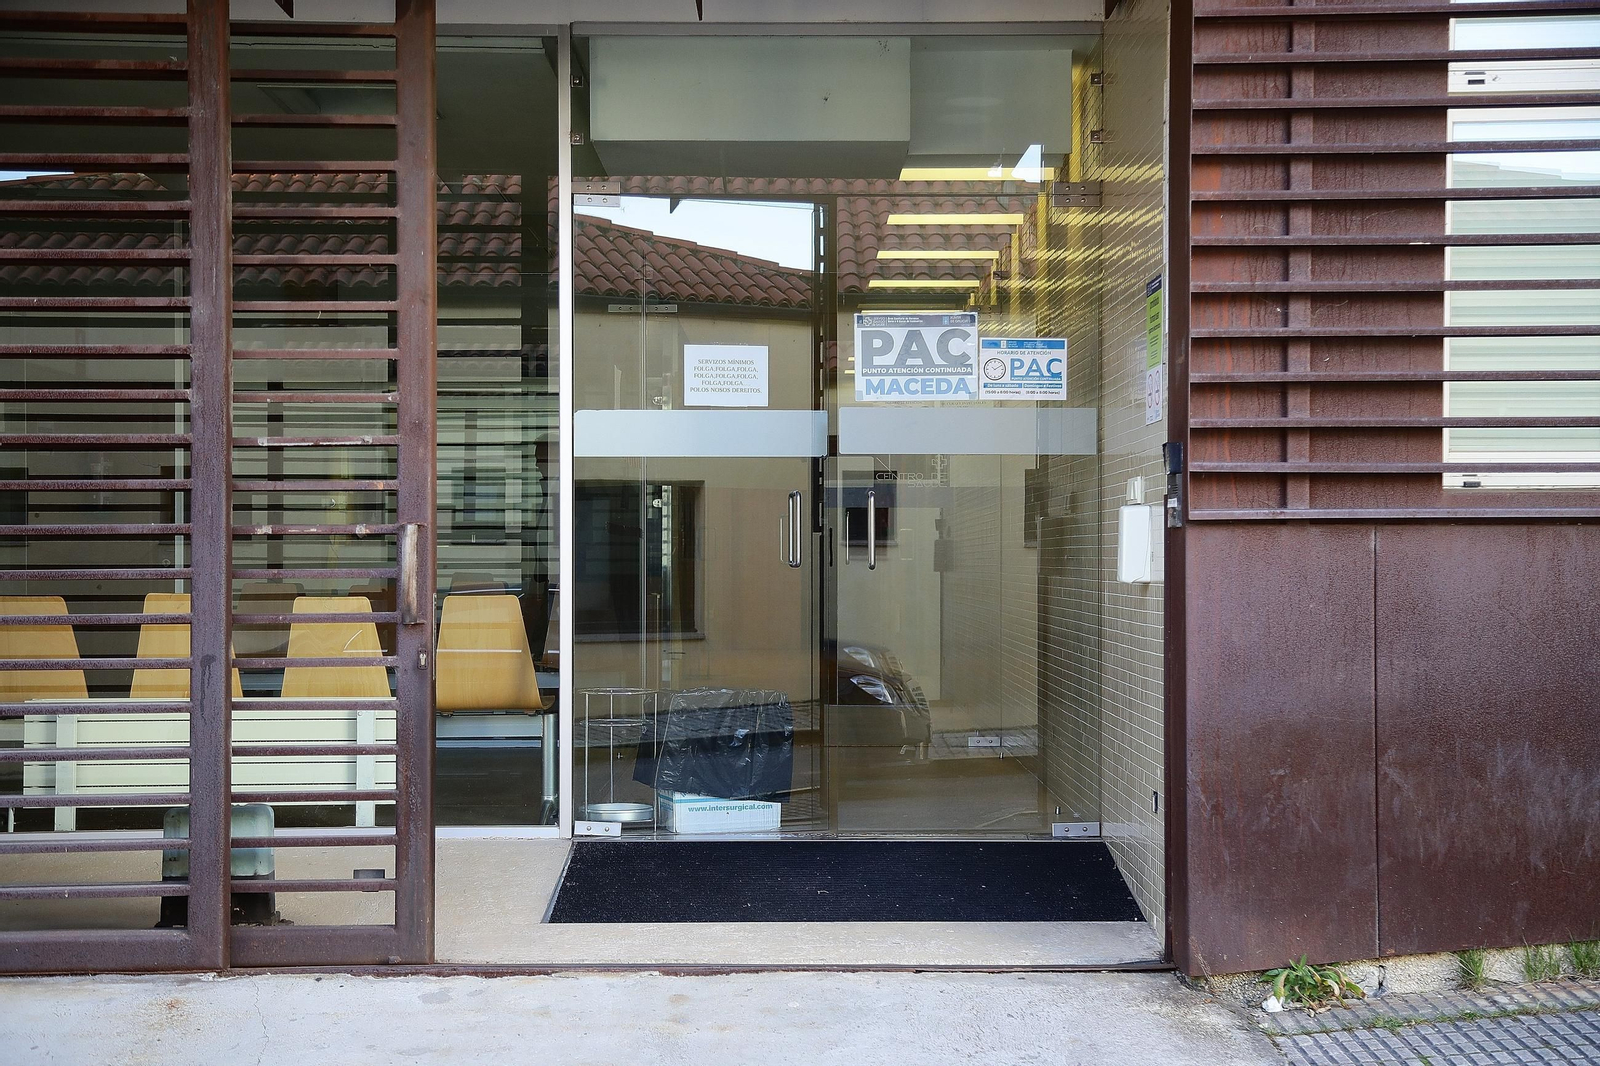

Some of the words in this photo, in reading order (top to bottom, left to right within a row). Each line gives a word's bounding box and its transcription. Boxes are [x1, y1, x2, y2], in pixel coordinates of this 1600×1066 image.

[861, 328, 972, 366] PAC
[727, 358, 755, 366] MÍNIMOS
[1010, 358, 1062, 377] PAC
[888, 366, 924, 374] ATENCIÓN
[865, 377, 972, 396] MACEDA
[688, 803, 773, 812] www.intersurgical.com
